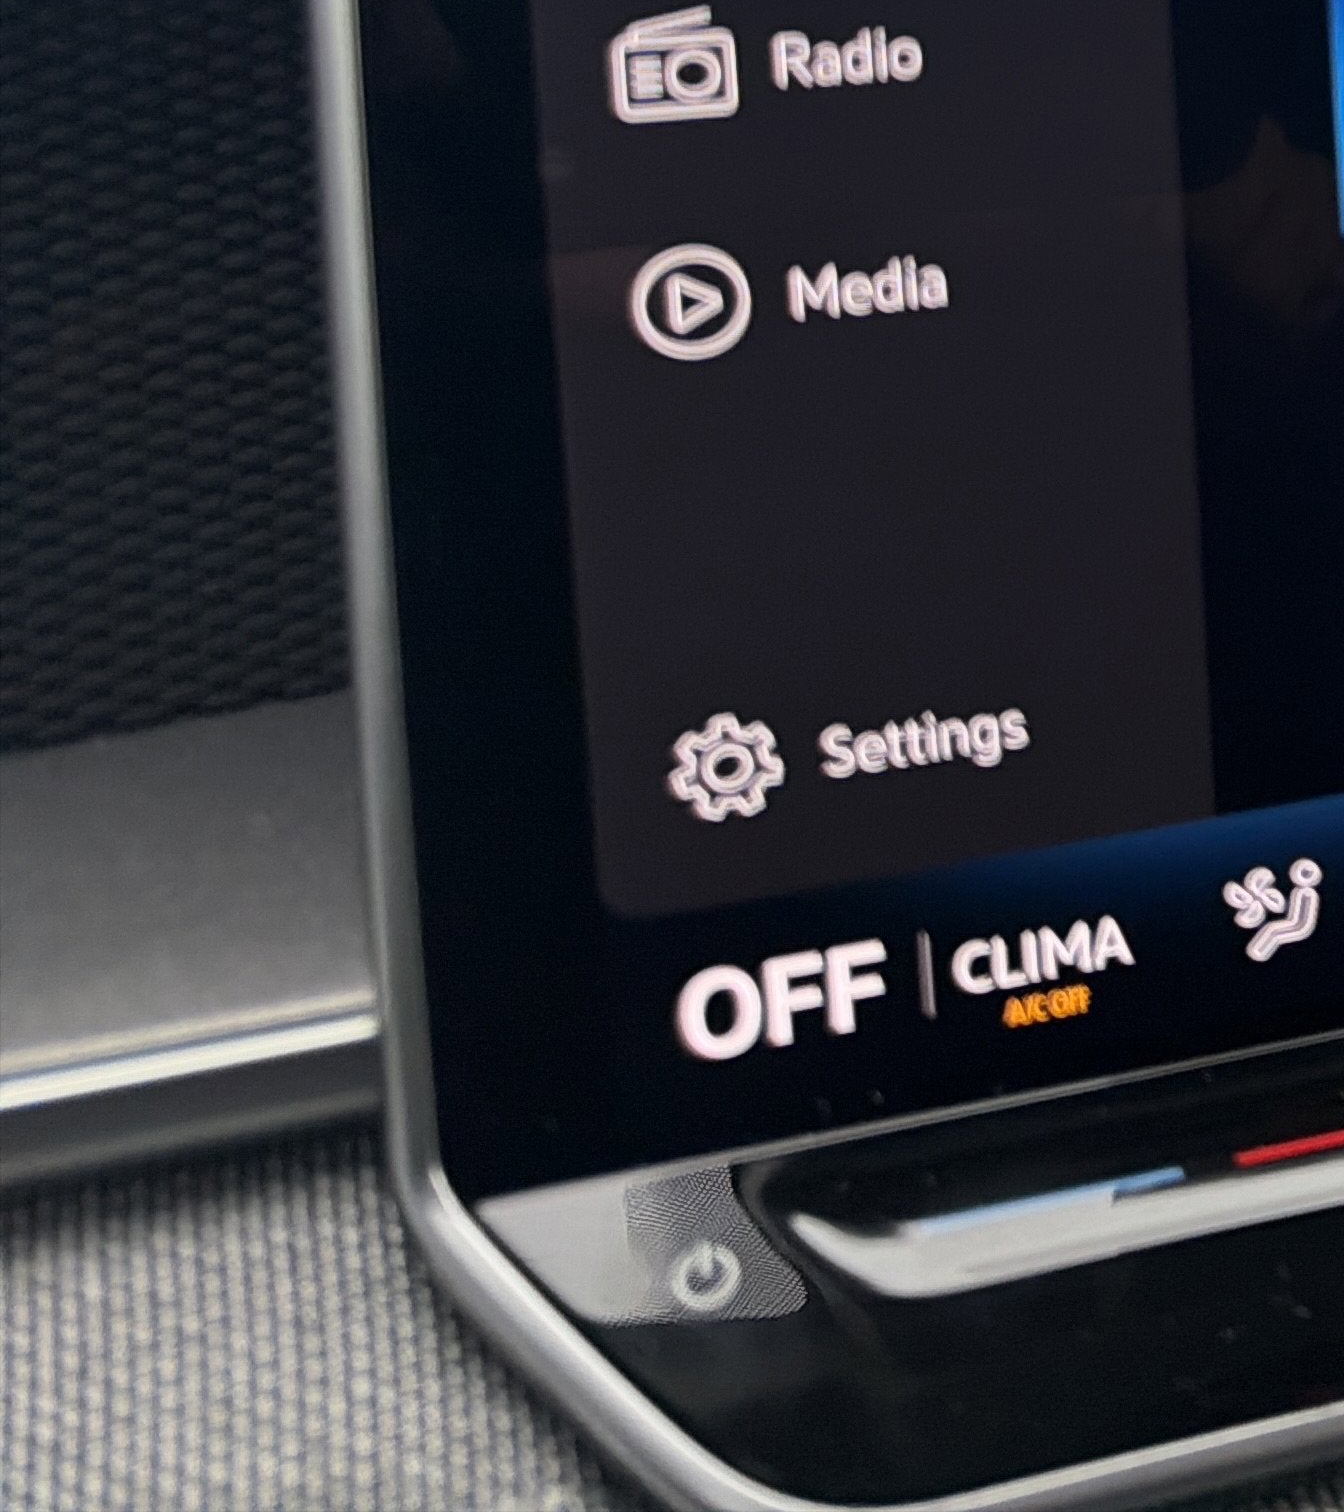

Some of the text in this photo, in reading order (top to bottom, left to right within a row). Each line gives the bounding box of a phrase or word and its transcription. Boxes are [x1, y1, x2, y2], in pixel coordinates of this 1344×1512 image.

[770, 26, 924, 90] Radio
[787, 255, 950, 323] Media
[818, 708, 1030, 780] Settings
[951, 914, 1136, 996] CLIMA
[676, 938, 888, 1061] OFF
